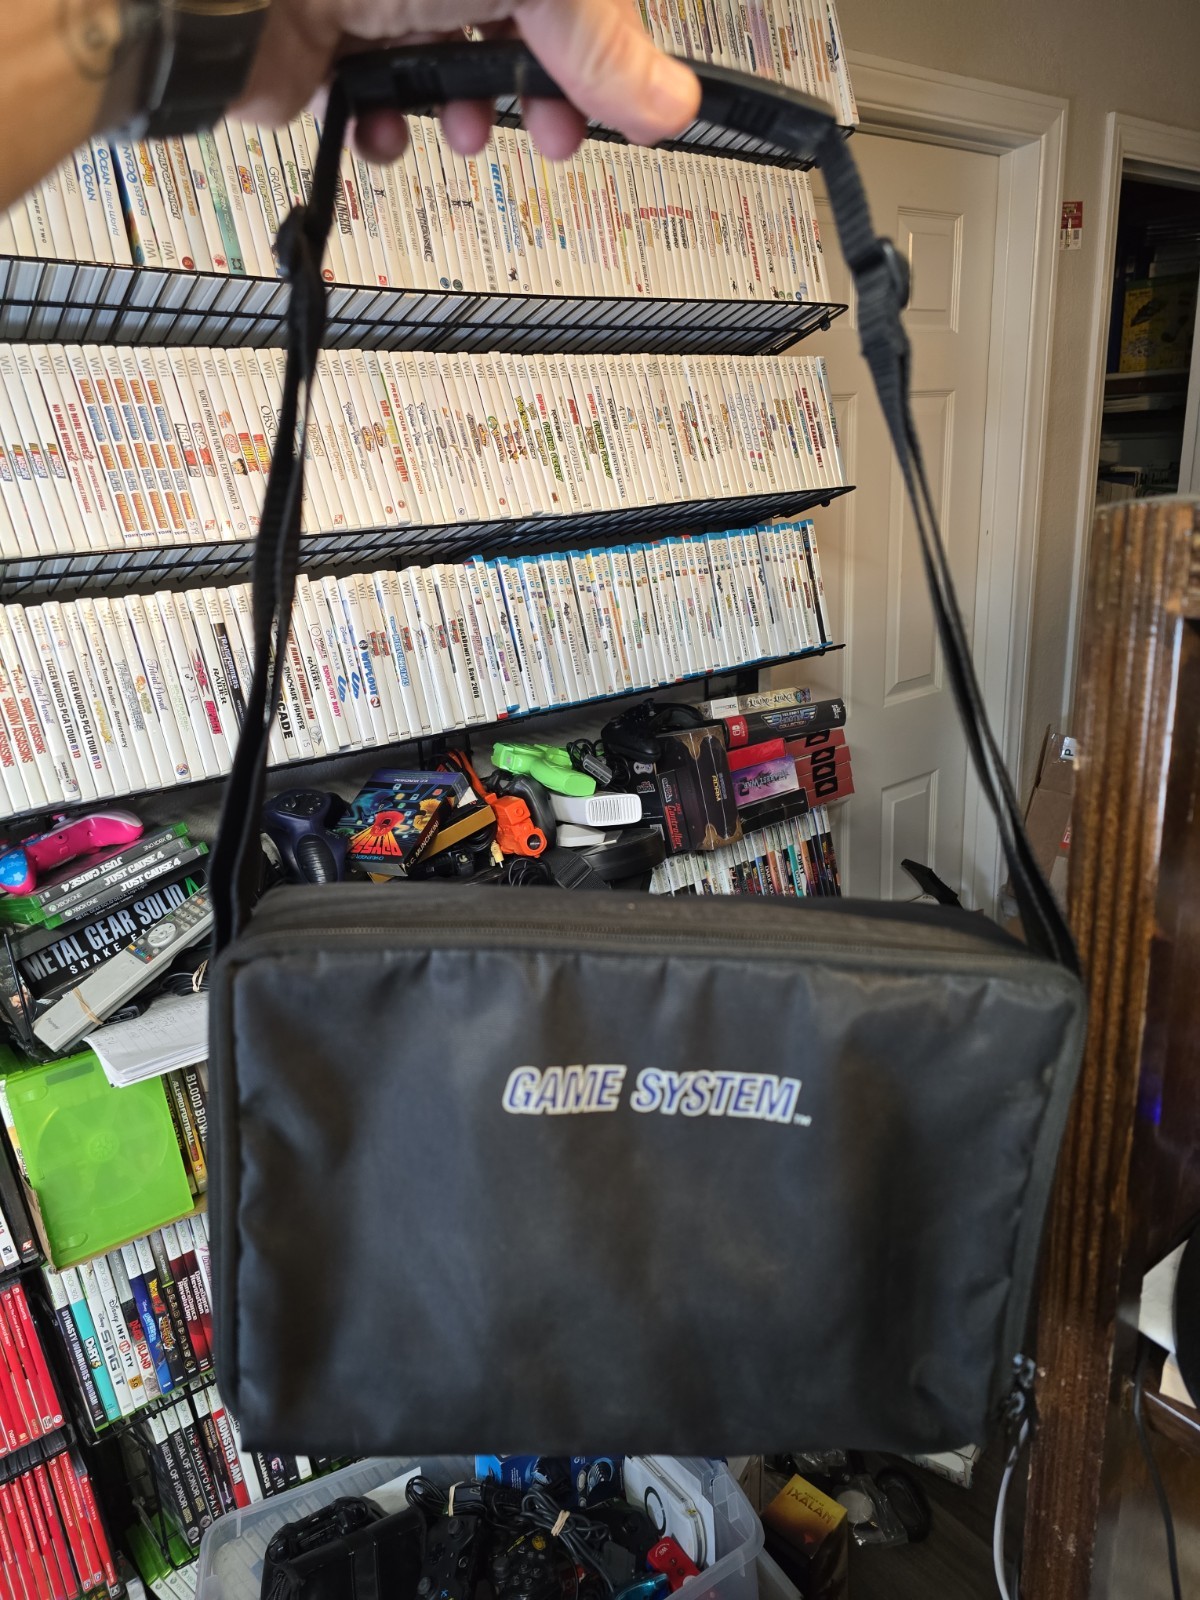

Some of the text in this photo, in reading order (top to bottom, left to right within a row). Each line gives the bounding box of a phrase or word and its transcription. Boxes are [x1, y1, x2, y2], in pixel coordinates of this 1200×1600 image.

[122, 146, 138, 184] OCEAN
[491, 163, 500, 181] ICE
[623, 152, 631, 167] Wii
[82, 164, 96, 201] OCEAN
[268, 166, 286, 209] GRAVITY
[493, 183, 503, 203] AGE
[134, 185, 147, 216] ENDLESS
[39, 228, 47, 244] TWO
[109, 211, 120, 236] World
[53, 356, 68, 375] Wii
[233, 360, 245, 378] Wii
[52, 404, 60, 413] NO
[54, 414, 66, 431] MORE
[67, 403, 76, 412] NO
[70, 413, 81, 431] MORE
[198, 389, 210, 408] NORTH
[212, 438, 224, 462] HUNTING
[390, 383, 424, 495] PRESS YOUR 2010 EDITION
[59, 432, 73, 455] HEROES
[75, 431, 89, 455] HEROES
[457, 618, 471, 657] SmackDown
[468, 667, 476, 681] Raw
[44, 658, 58, 681] TIGER
[66, 670, 80, 692] TIGER
[360, 651, 378, 696] WIPEOUT
[52, 680, 67, 709] WOODS
[73, 692, 88, 719] WOODS
[95, 649, 105, 667] Croft
[101, 667, 110, 685] Tomb
[114, 710, 128, 748] Anniversary
[283, 666, 305, 731] DINOSAUR HUNTER
[296, 674, 312, 705] DOWNHILL
[305, 707, 315, 720] JAM
[322, 665, 341, 718] KNOCK-OUT BODY
[59, 708, 71, 725] PGA
[80, 719, 93, 736] PGA
[64, 724, 77, 745] TOUR
[84, 735, 98, 756] TOUR
[61, 857, 123, 893] JUST CAUSE 4
[104, 850, 165, 885] JUST CAUSE 4
[120, 857, 181, 892] JUST CAUSE 4
[23, 939, 89, 983] METAL
[84, 911, 137, 952] GEAR
[139, 883, 186, 924] SOLID
[69, 944, 122, 975] SNAKE
[186, 1073, 202, 1107] BLOOD
[502, 1064, 627, 1115] GAME
[61, 1310, 76, 1341] DYNASTY
[108, 1299, 118, 1323] Disney
[116, 1324, 134, 1368] INFINITY
[101, 1329, 125, 1391] SING IT
[130, 1319, 151, 1370] DEAD ISLAND
[173, 1431, 200, 1498] MEDAL OF HONOR
[216, 1416, 243, 1485] MONSTER JAM
[160, 1442, 188, 1509] MEDAL OF HONOR
[186, 1427, 220, 1518] THE PHANTOM PAIN
